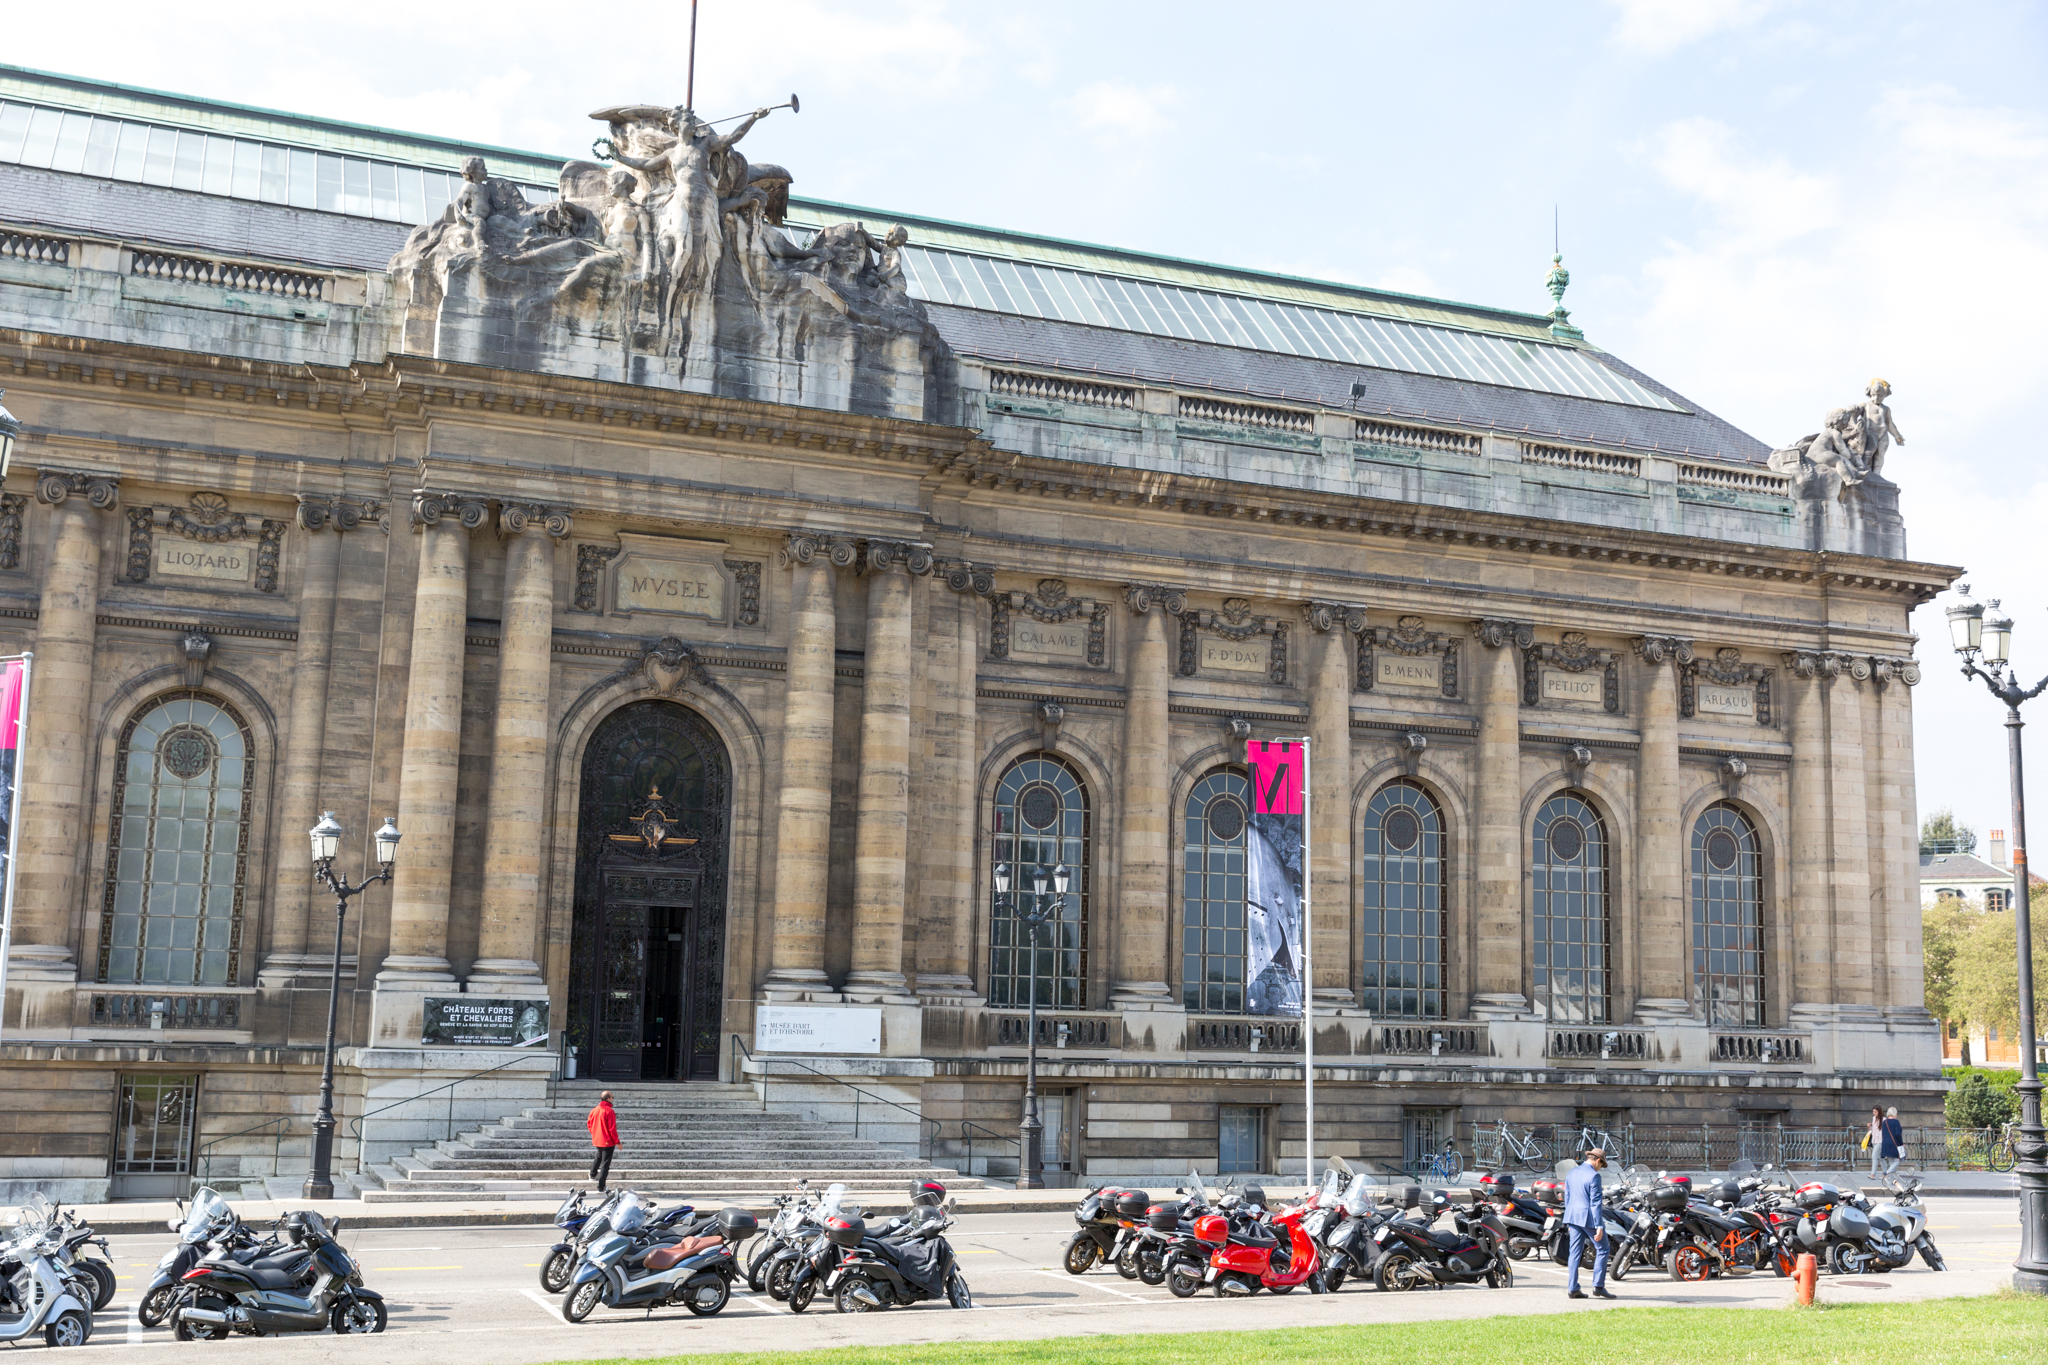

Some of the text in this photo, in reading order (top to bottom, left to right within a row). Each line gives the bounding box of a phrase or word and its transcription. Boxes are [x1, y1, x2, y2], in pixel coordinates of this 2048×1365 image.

[165, 551, 241, 569] LIOTARD
[631, 576, 710, 599] MVSEE
[1020, 631, 1077, 647] CALAME
[1208, 648, 1217, 660] F.
[1395, 665, 1433, 679] MENN
[1548, 679, 1596, 694] PETITOT
[1704, 694, 1748, 707] ARLAUD
[443, 1004, 514, 1015] CHÂTEAUX FORTS
[449, 1014, 514, 1023] ET CHEVALIERS
